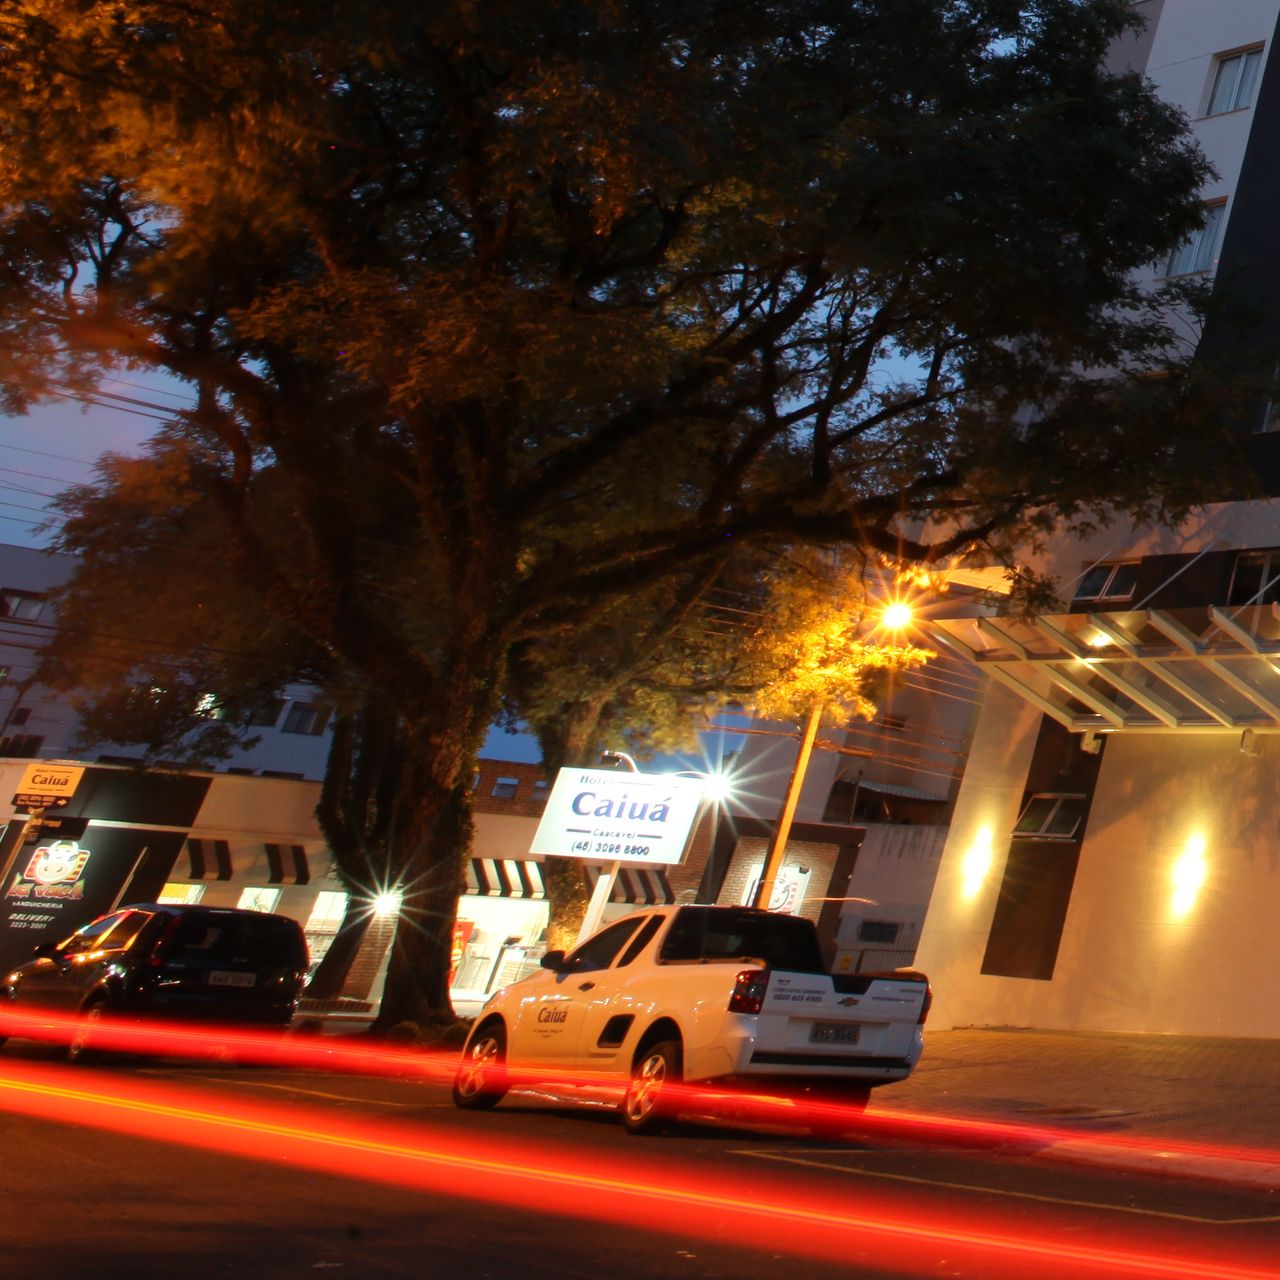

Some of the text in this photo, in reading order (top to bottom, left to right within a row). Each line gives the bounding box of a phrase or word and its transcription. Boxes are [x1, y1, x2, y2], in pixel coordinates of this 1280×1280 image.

[31, 773, 70, 786] Caiuá
[571, 791, 673, 823] Caiuá
[8, 913, 55, 922] DELIVERY
[537, 1006, 569, 1023] Caiuá
